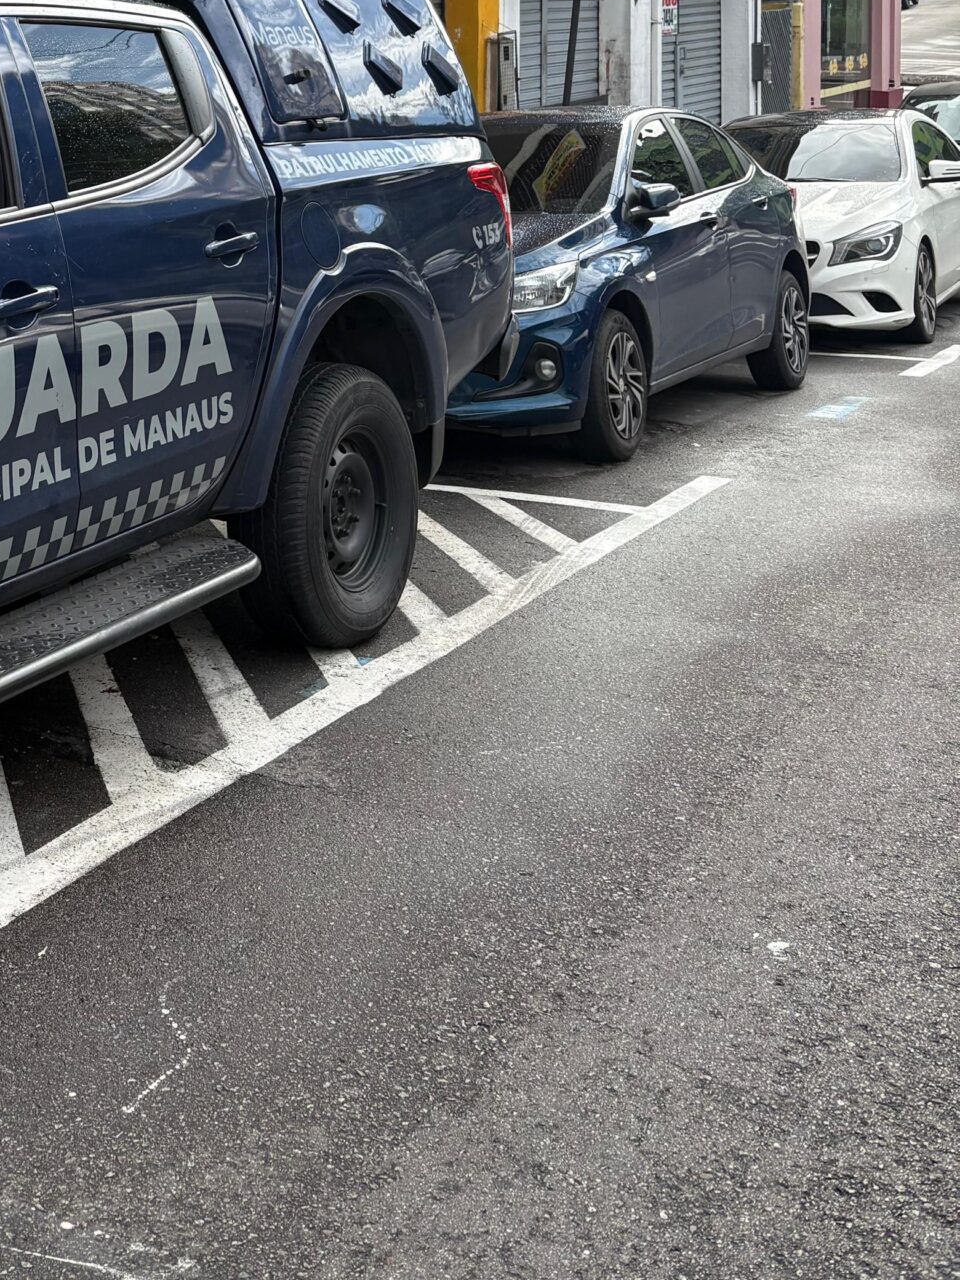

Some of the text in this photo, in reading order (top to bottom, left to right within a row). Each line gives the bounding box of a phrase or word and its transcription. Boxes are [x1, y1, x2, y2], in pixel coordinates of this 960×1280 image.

[251, 22, 315, 47] Manaus
[482, 223, 500, 245] 153
[78, 434, 118, 475] DE
[123, 392, 235, 455] MANAUS
